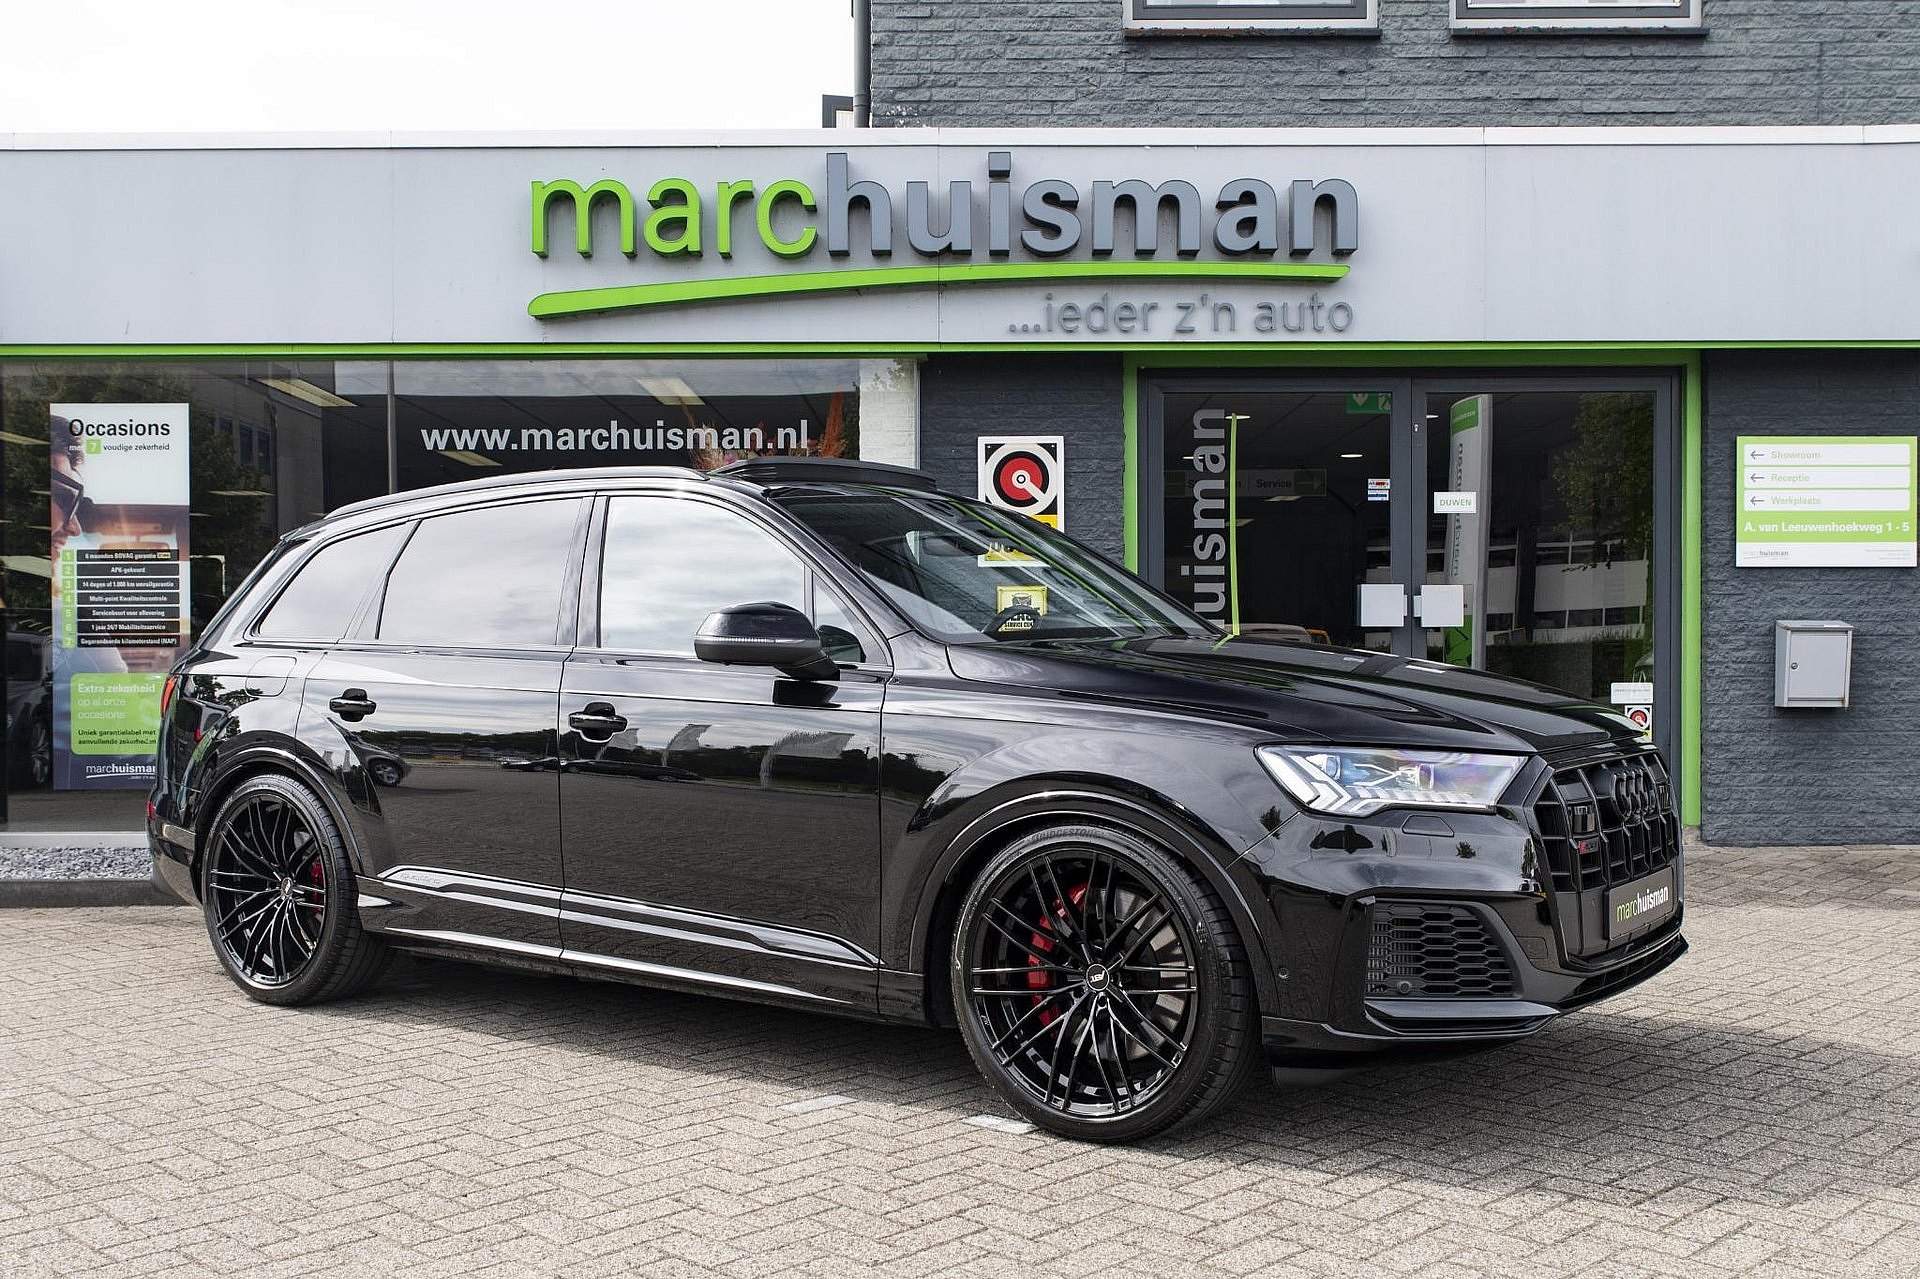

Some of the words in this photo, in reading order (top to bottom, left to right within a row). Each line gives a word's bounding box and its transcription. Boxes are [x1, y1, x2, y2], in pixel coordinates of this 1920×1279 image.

[529, 151, 1360, 259] marchuisman
[1174, 293, 1236, 333] z'n
[1253, 292, 1354, 333] auto
[69, 418, 170, 436] Occasions
[421, 420, 808, 451] www.marchuisman.nl
[88, 442, 97, 452] 7
[103, 443, 133, 452] voudige
[134, 443, 170, 451] zekerheid
[1770, 450, 1821, 460] Showroom
[1255, 478, 1292, 489] Service
[1770, 473, 1810, 484] Receptie
[1439, 499, 1472, 507] DUWEN
[1770, 495, 1822, 506] Werkplaats
[1181, 408, 1226, 630] uisman
[1743, 521, 1756, 533] A.
[1758, 523, 1779, 533] van
[1781, 521, 1883, 534] Leeuwenhoekweg
[1886, 522, 1892, 532] 1
[1902, 522, 1910, 532] 5
[65, 609, 71, 617] 5
[78, 683, 104, 693] Extra
[108, 683, 155, 693] zekerheid
[98, 729, 141, 737] garantielabel
[1616, 885, 1669, 921] marchuisman
